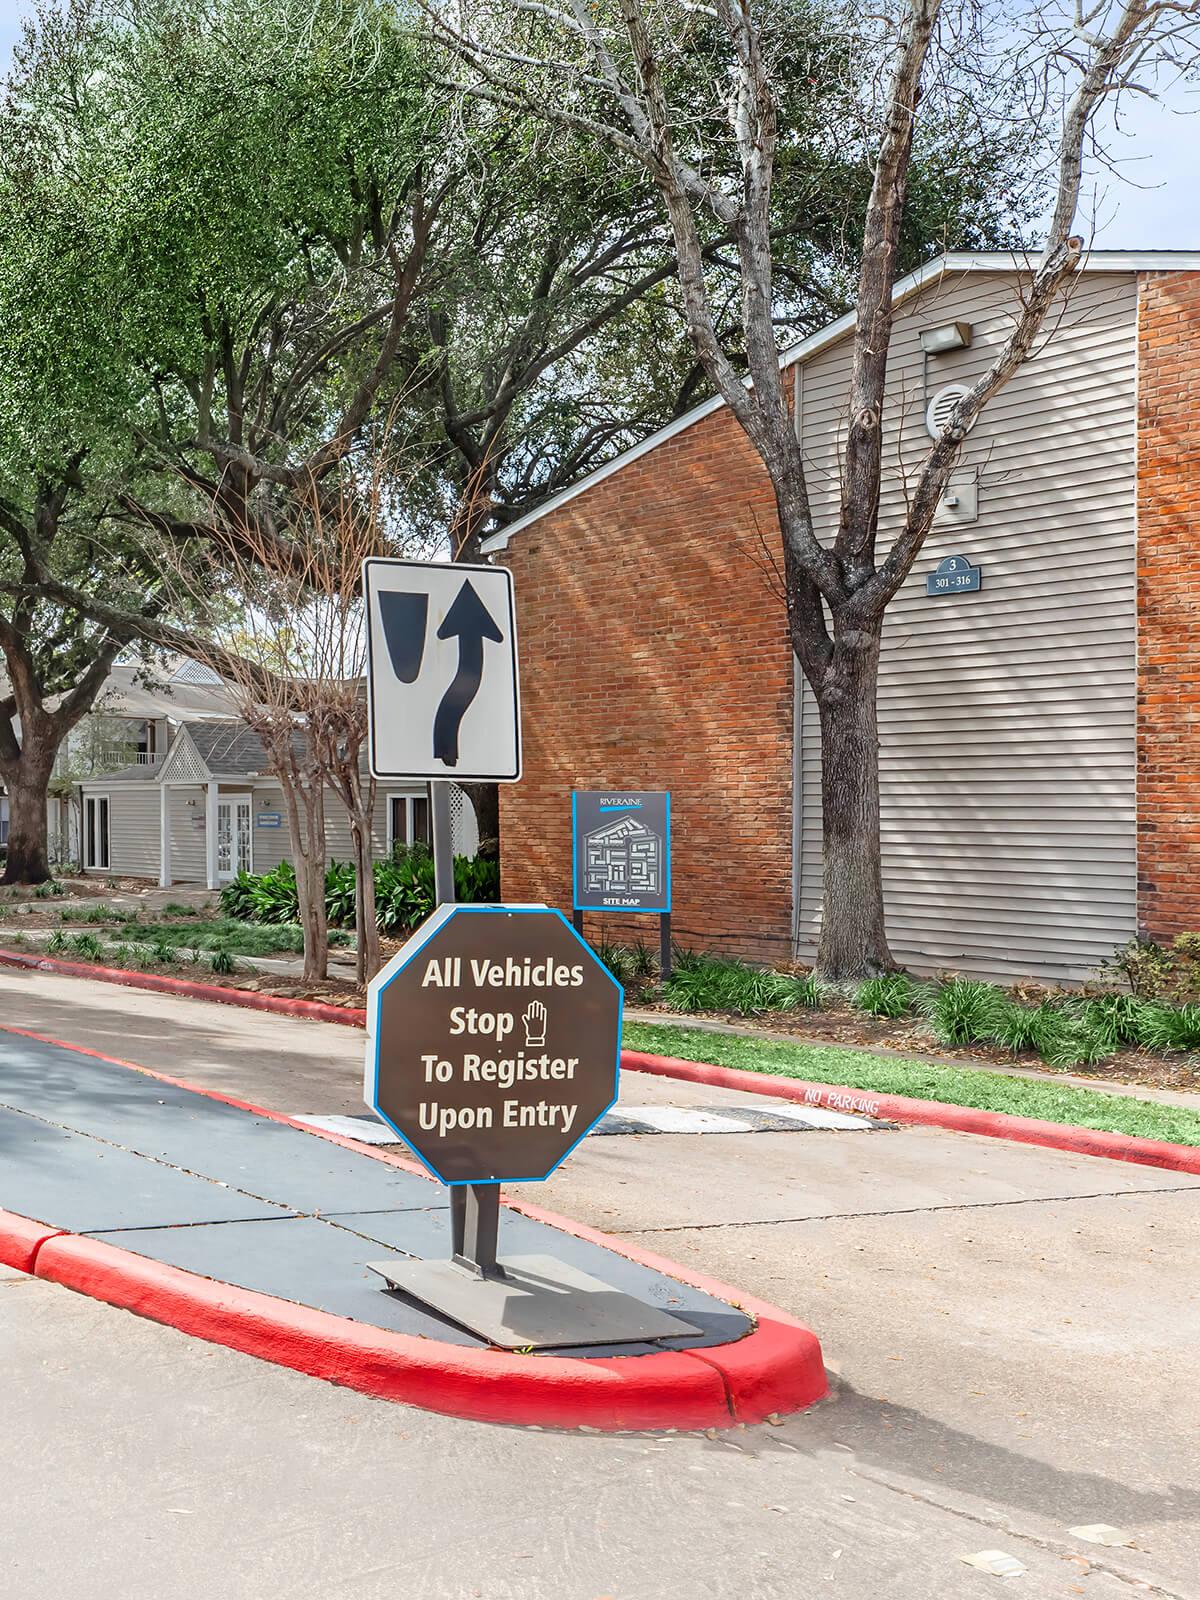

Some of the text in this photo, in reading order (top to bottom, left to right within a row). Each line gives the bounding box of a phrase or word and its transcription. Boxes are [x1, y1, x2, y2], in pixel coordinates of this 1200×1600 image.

[949, 559, 957, 571] 3
[935, 578, 949, 588] 301
[956, 575, 971, 586] 316
[600, 798, 642, 806] RIVERAINE
[421, 957, 584, 987] All Vehicles
[449, 1007, 514, 1041] Stop
[420, 1052, 579, 1089] To Register
[804, 1088, 880, 1113] NO PARKING
[419, 1100, 578, 1137] Upon Entry
